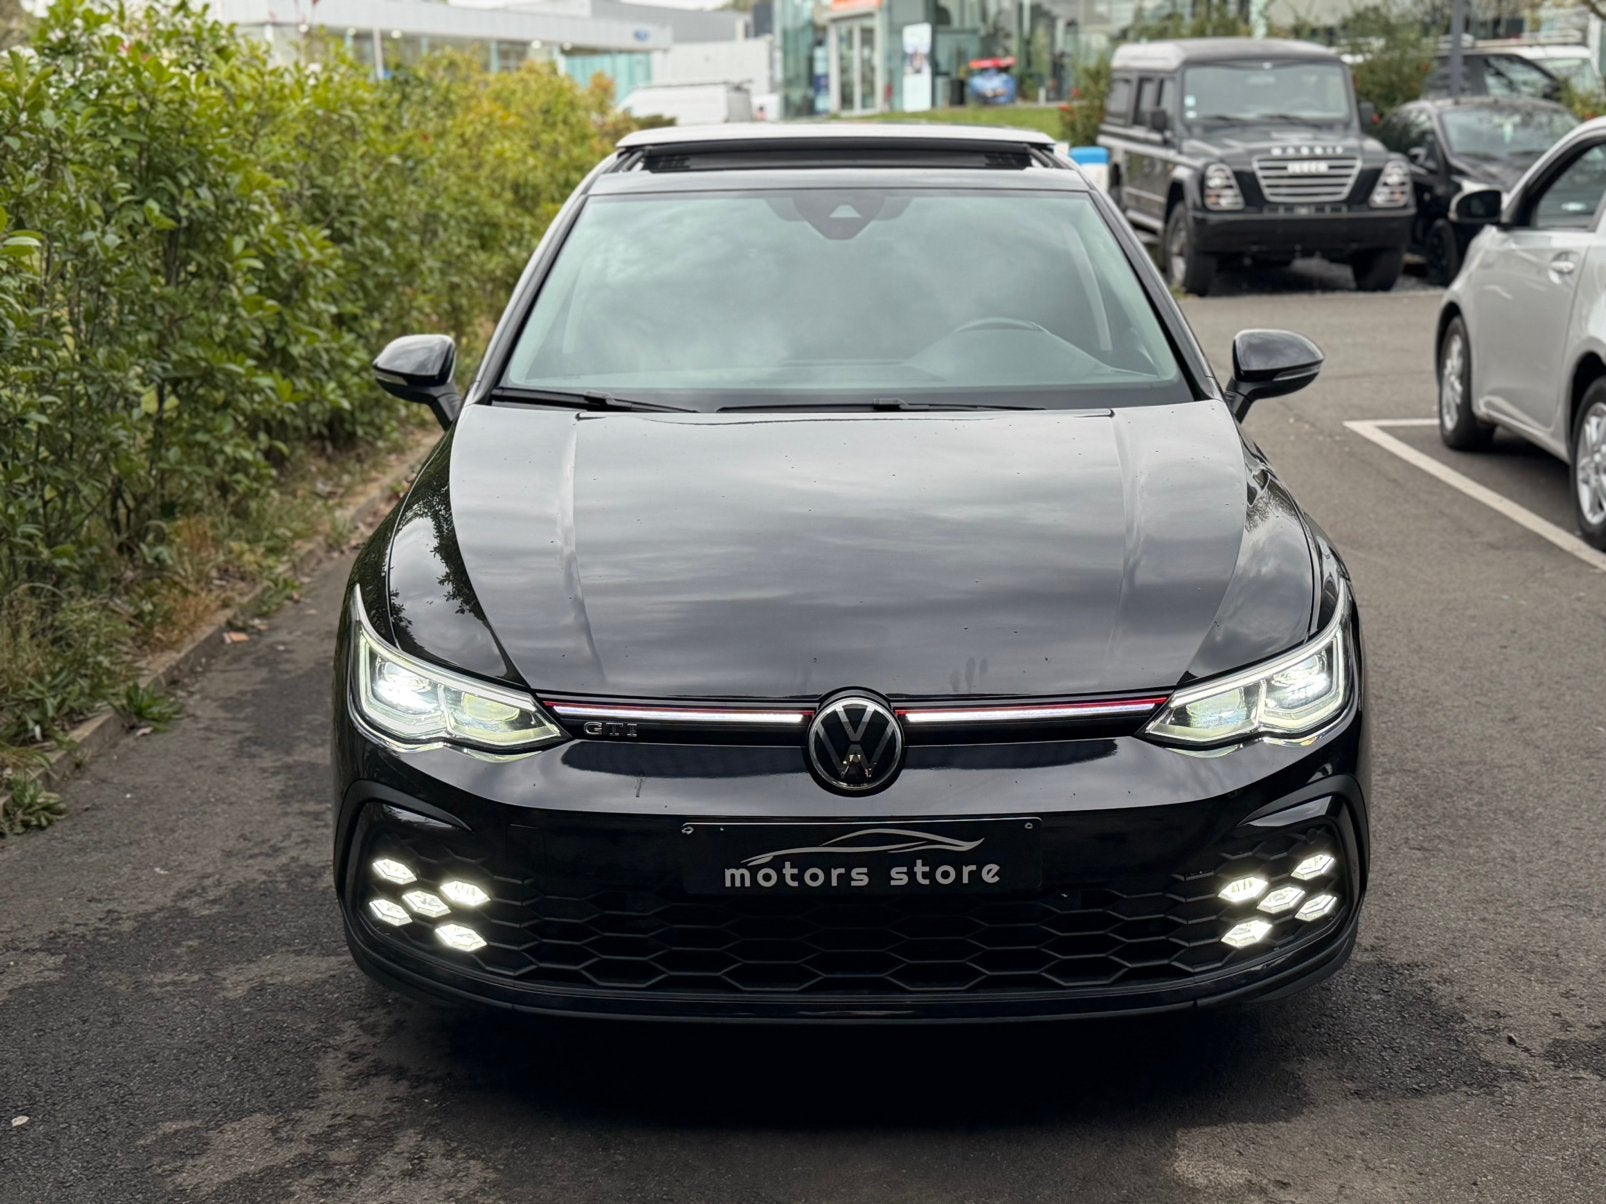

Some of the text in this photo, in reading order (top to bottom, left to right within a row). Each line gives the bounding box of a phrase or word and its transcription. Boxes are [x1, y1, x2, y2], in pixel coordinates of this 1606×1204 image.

[584, 721, 638, 737] GTI
[724, 859, 1001, 888] motors store
